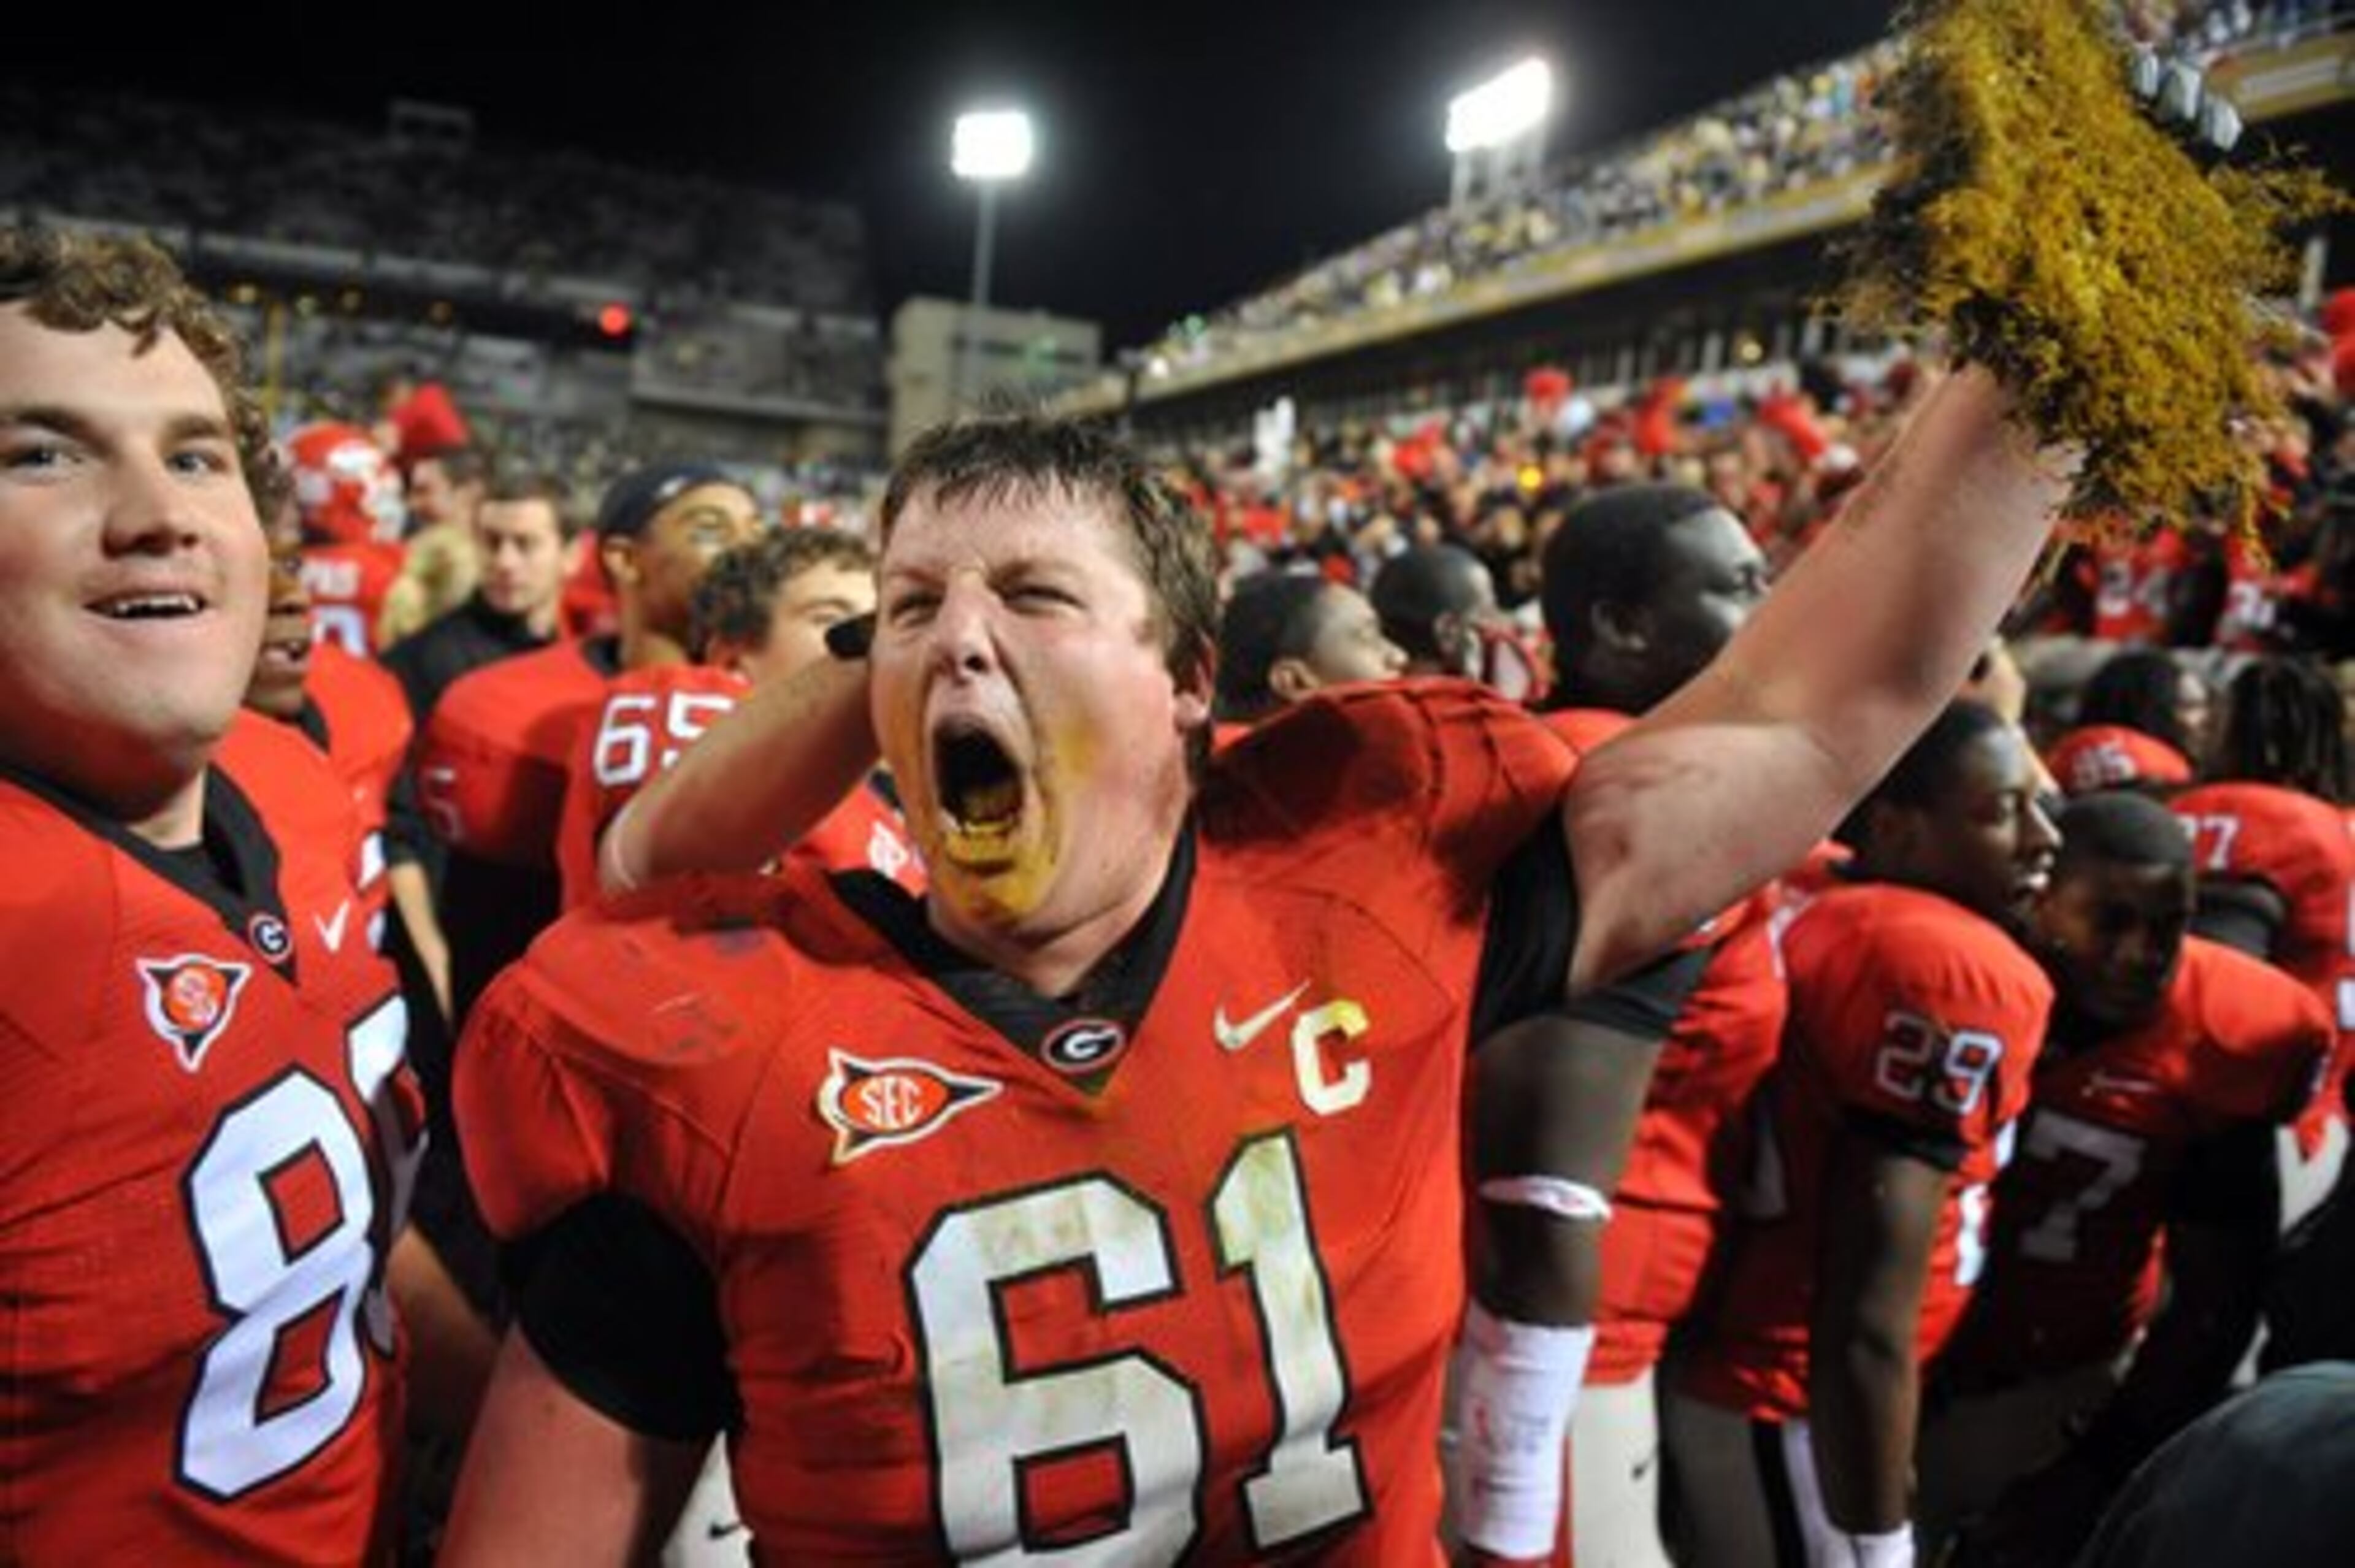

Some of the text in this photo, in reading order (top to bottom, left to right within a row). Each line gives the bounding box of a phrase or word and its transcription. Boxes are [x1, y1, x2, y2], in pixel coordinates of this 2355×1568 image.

[592, 692, 733, 786] 65
[1063, 1027, 1119, 1059] G
[1291, 998, 1371, 1116] C
[1875, 1009, 2004, 1117] 29
[860, 1074, 923, 1130] SEC
[2024, 1107, 2145, 1261] 7
[900, 1128, 1375, 1568] 61
